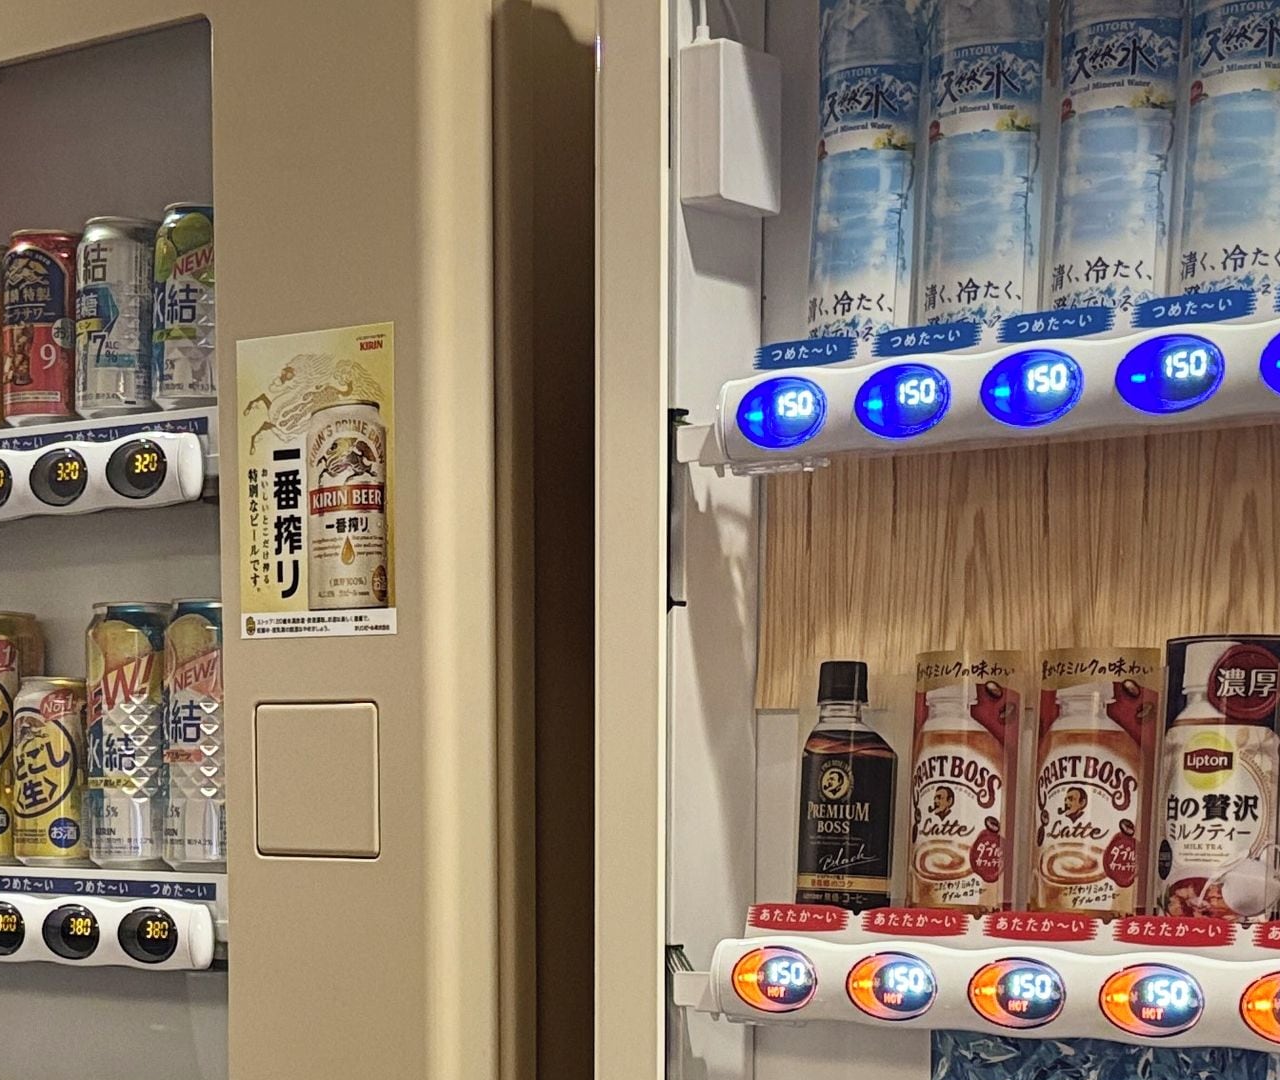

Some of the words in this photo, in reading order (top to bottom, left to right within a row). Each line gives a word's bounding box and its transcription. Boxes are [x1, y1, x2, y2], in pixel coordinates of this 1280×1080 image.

[1052, 256, 1153, 293] 清く、冷たく、
[39, 343, 57, 370] 9
[359, 340, 384, 352] KIRIN
[1028, 364, 1067, 392] 150
[134, 453, 158, 474] 320
[312, 490, 347, 511] KIRIN
[352, 489, 383, 506] BEER
[248, 468, 262, 594] 特別なビールです。
[273, 448, 303, 599] 一番搾り
[325, 516, 370, 534] 一番搾り
[173, 660, 217, 693] NEW!
[1216, 668, 1280, 698] 濃厚
[1186, 752, 1229, 769] Lipton
[807, 799, 870, 822] PREMIUM
[817, 820, 851, 835] BOSS
[919, 816, 975, 838] Latte
[1047, 818, 1109, 839] Latte
[1167, 822, 1252, 841] ミルクティー
[819, 846, 877, 870] Black
[145, 921, 169, 939] 380
[1147, 979, 1188, 1006] 150
